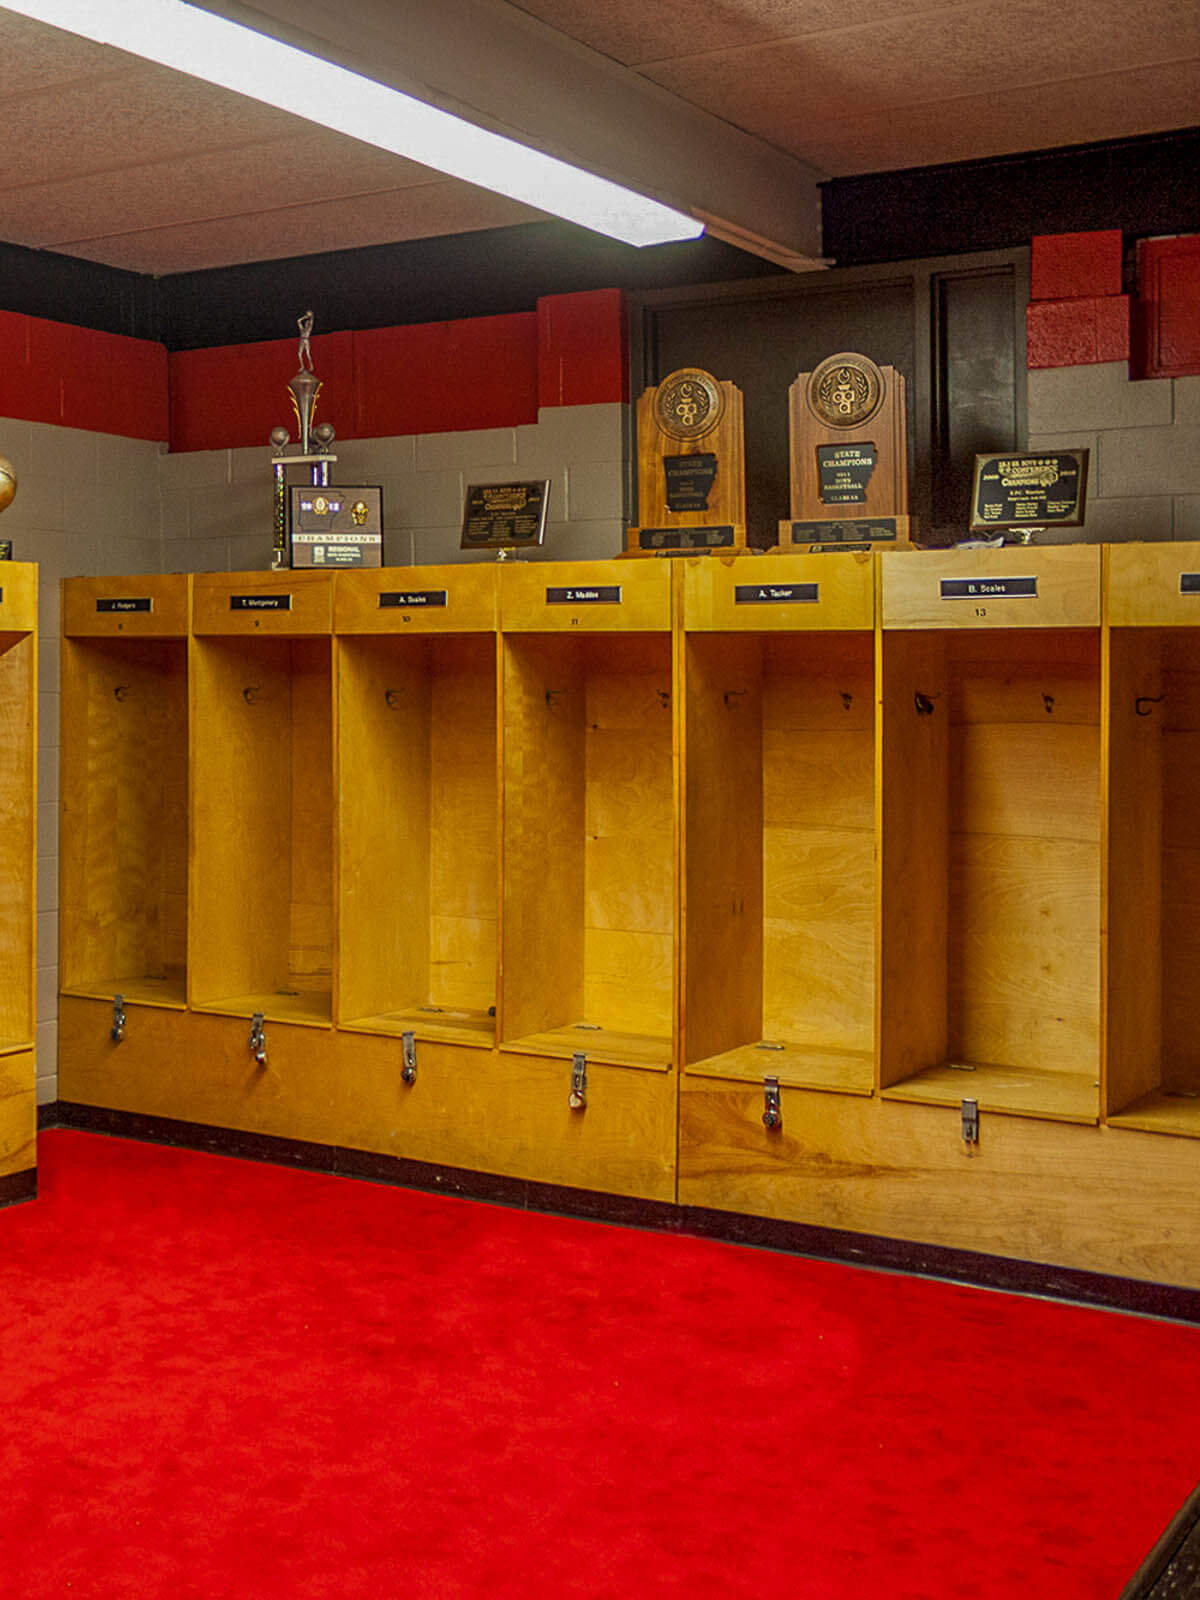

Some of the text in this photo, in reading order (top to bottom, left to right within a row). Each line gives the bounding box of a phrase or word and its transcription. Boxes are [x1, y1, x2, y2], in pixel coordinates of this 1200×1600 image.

[833, 450, 861, 459] STATE
[823, 458, 873, 468] CHAMPIONS
[327, 545, 360, 553] REGIONAL
[980, 584, 1006, 593] Scales
[975, 608, 987, 617] 13
